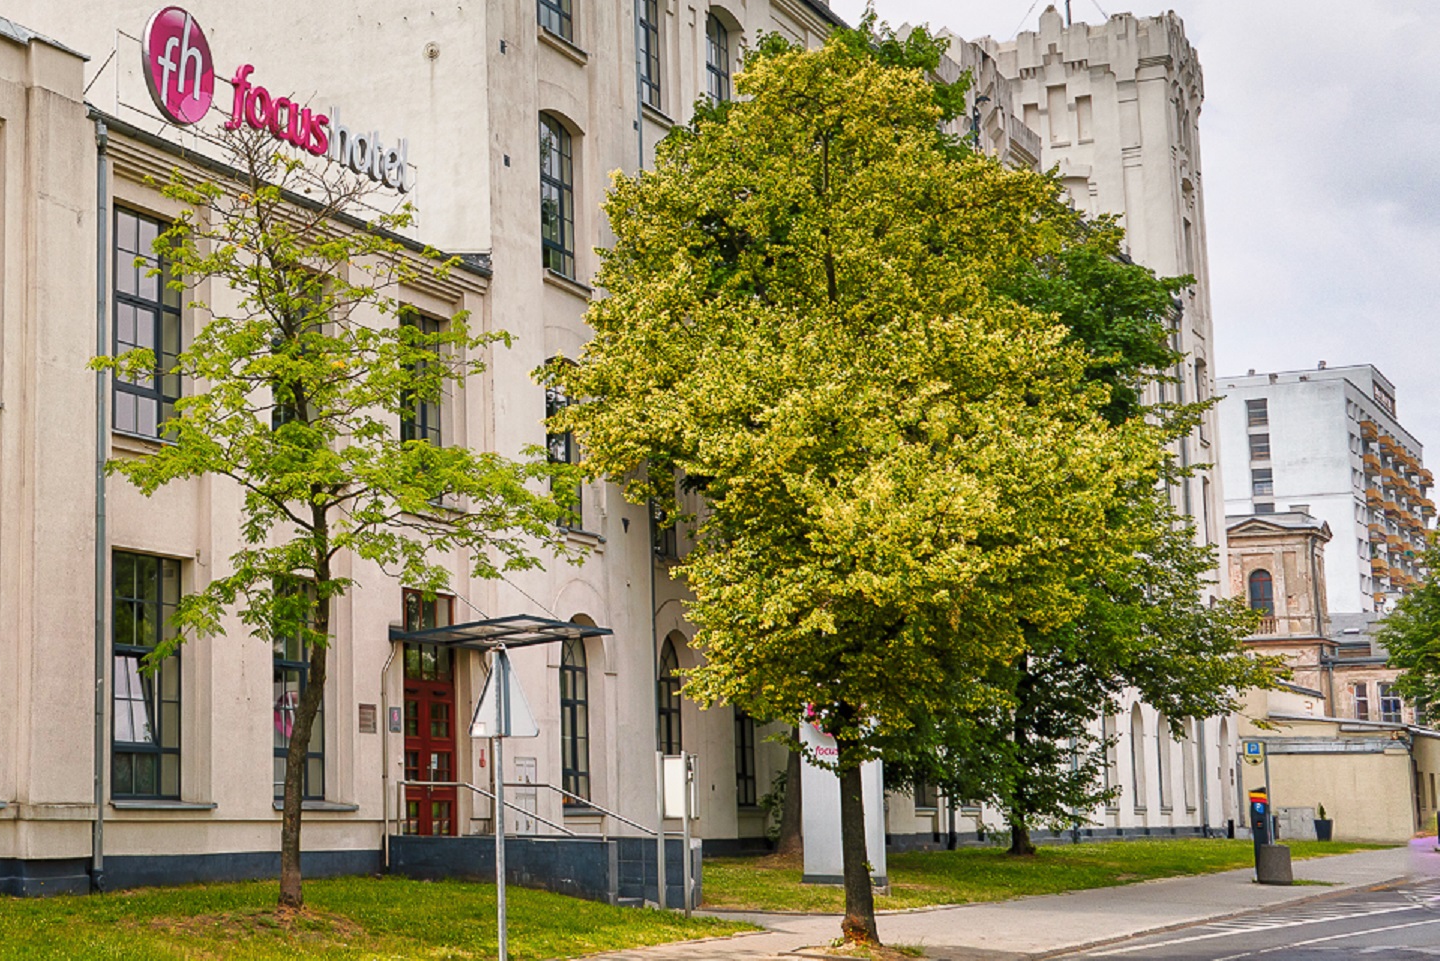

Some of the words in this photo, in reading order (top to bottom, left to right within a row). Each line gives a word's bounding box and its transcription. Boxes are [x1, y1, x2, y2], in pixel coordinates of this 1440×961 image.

[157, 11, 203, 107] fh
[224, 63, 330, 157] focus
[328, 105, 411, 194] hotel
